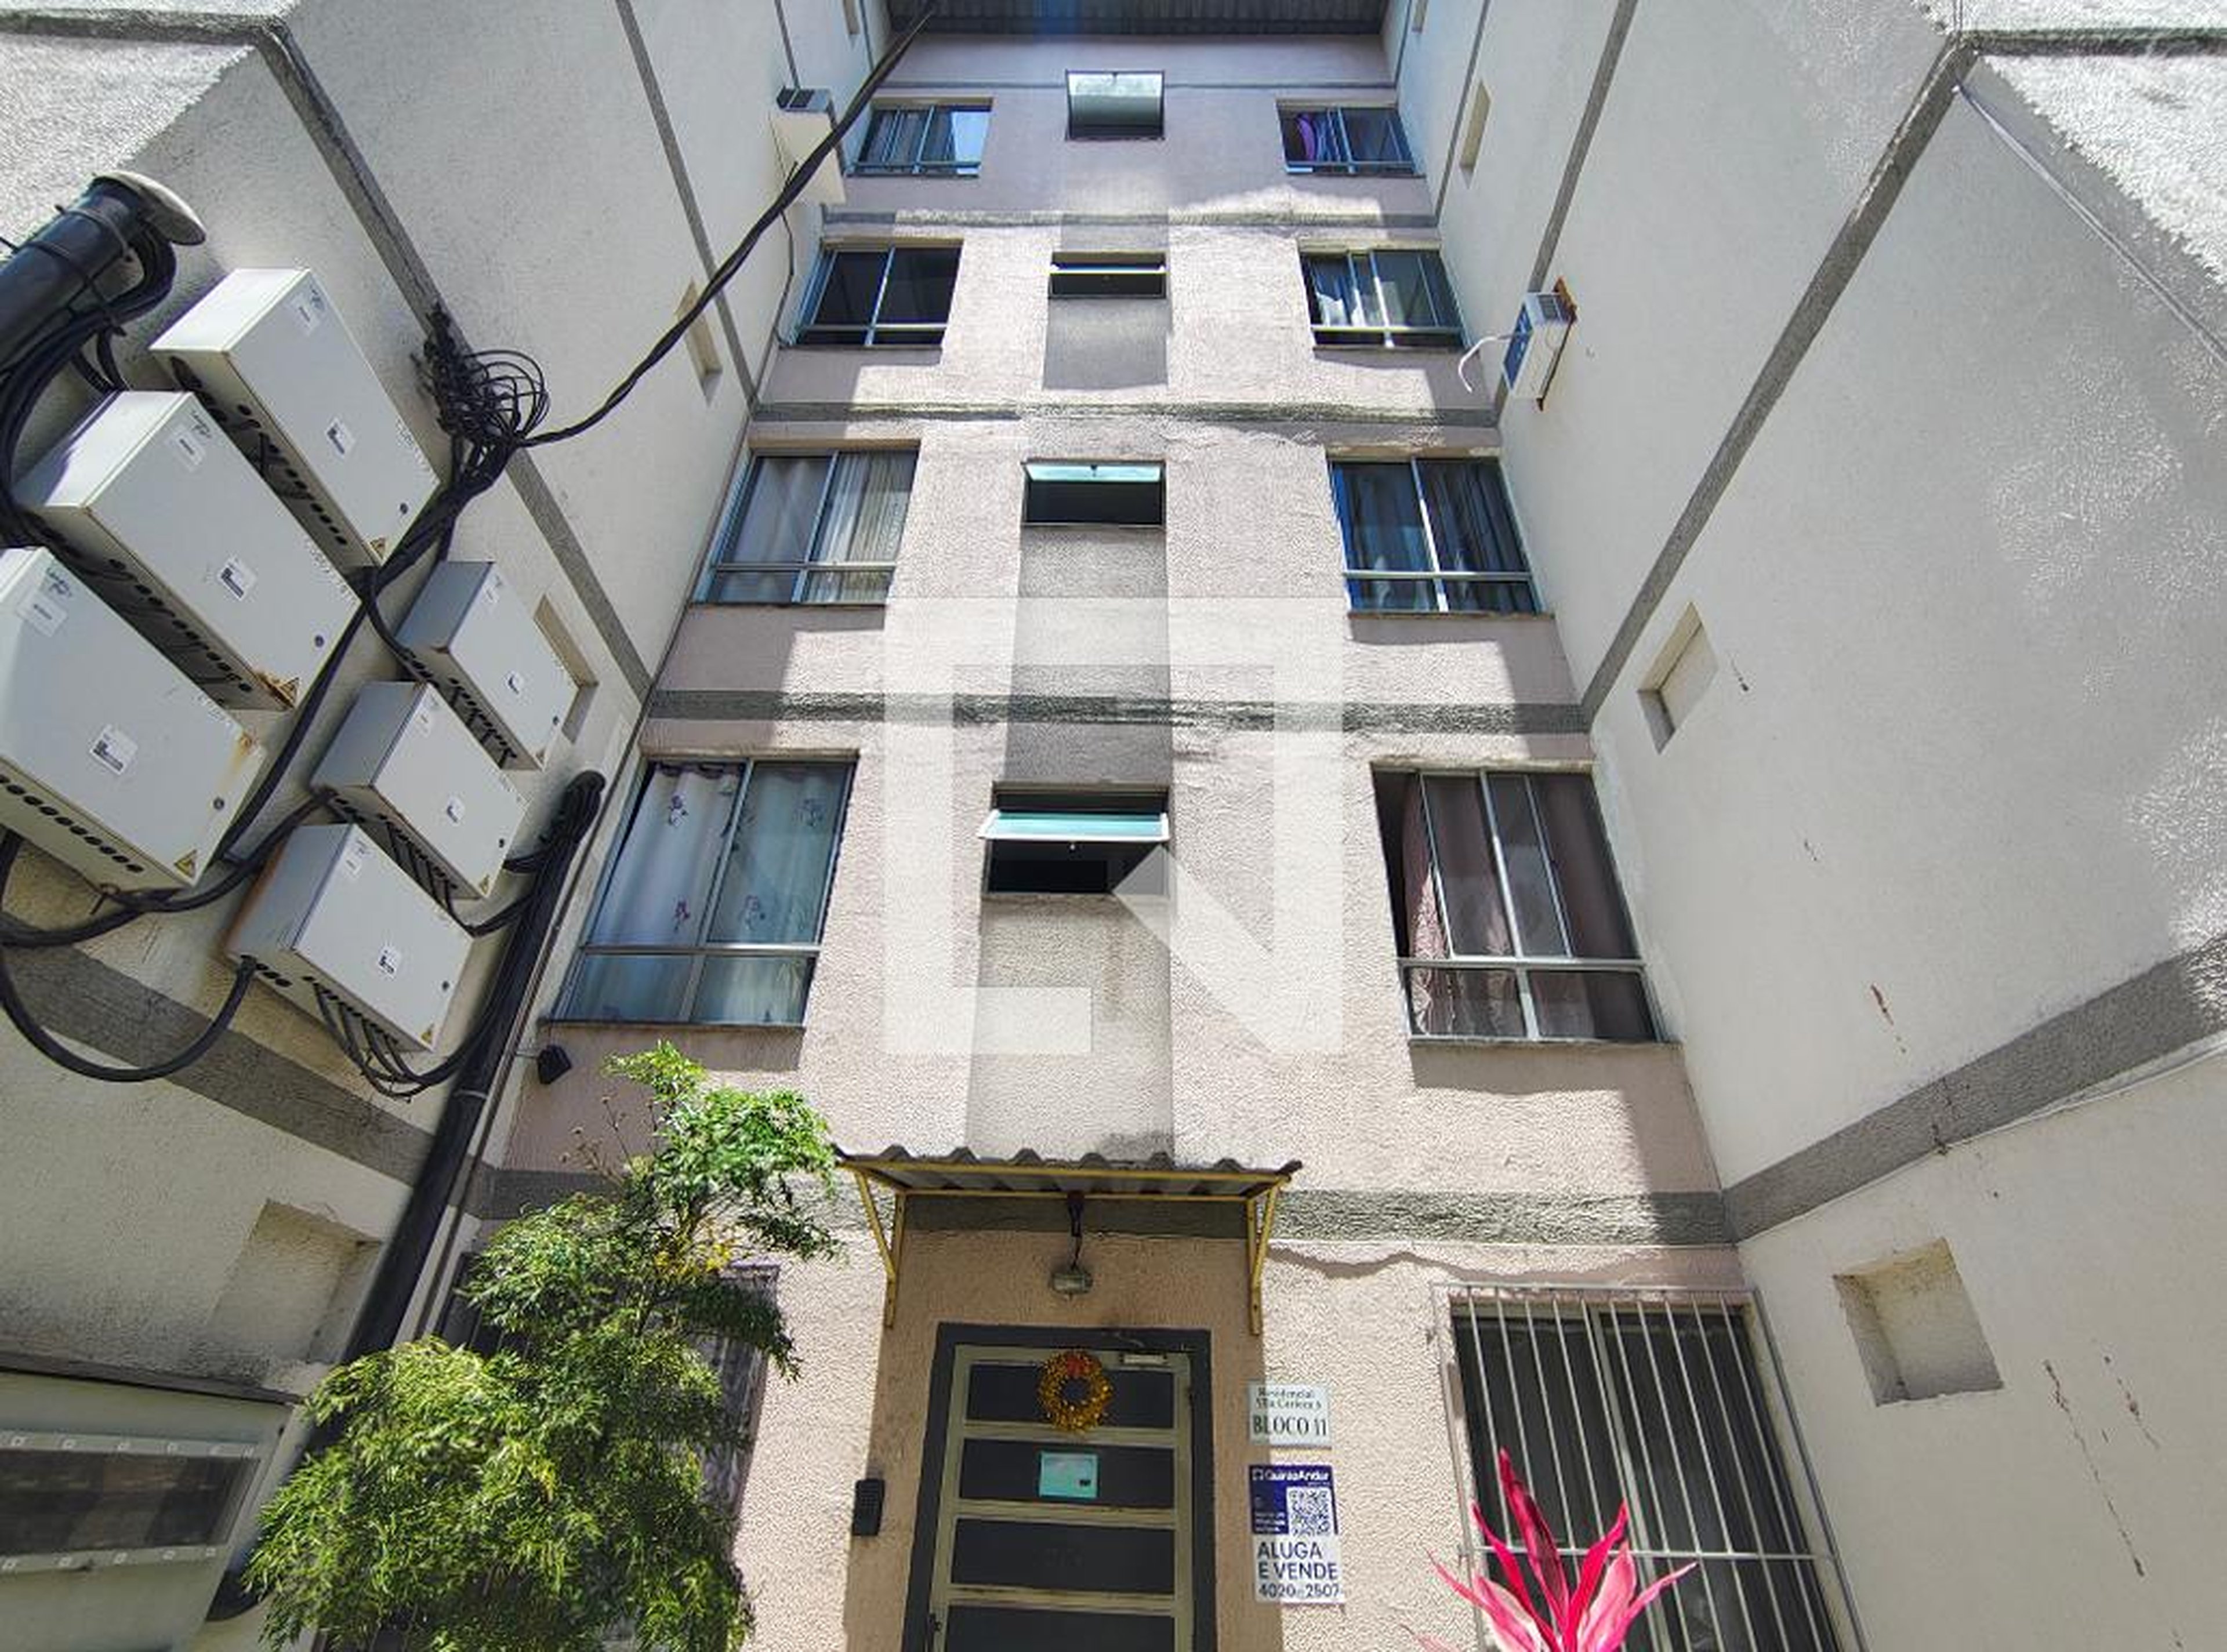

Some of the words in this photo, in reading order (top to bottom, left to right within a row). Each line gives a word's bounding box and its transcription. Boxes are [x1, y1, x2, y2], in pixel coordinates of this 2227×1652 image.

[1253, 1415, 1309, 1435] BLOCO
[1314, 1417, 1326, 1436] 11
[1257, 1542, 1323, 1559] ALUGA
[1258, 1563, 1269, 1579] E
[1274, 1563, 1338, 1580] VENDE
